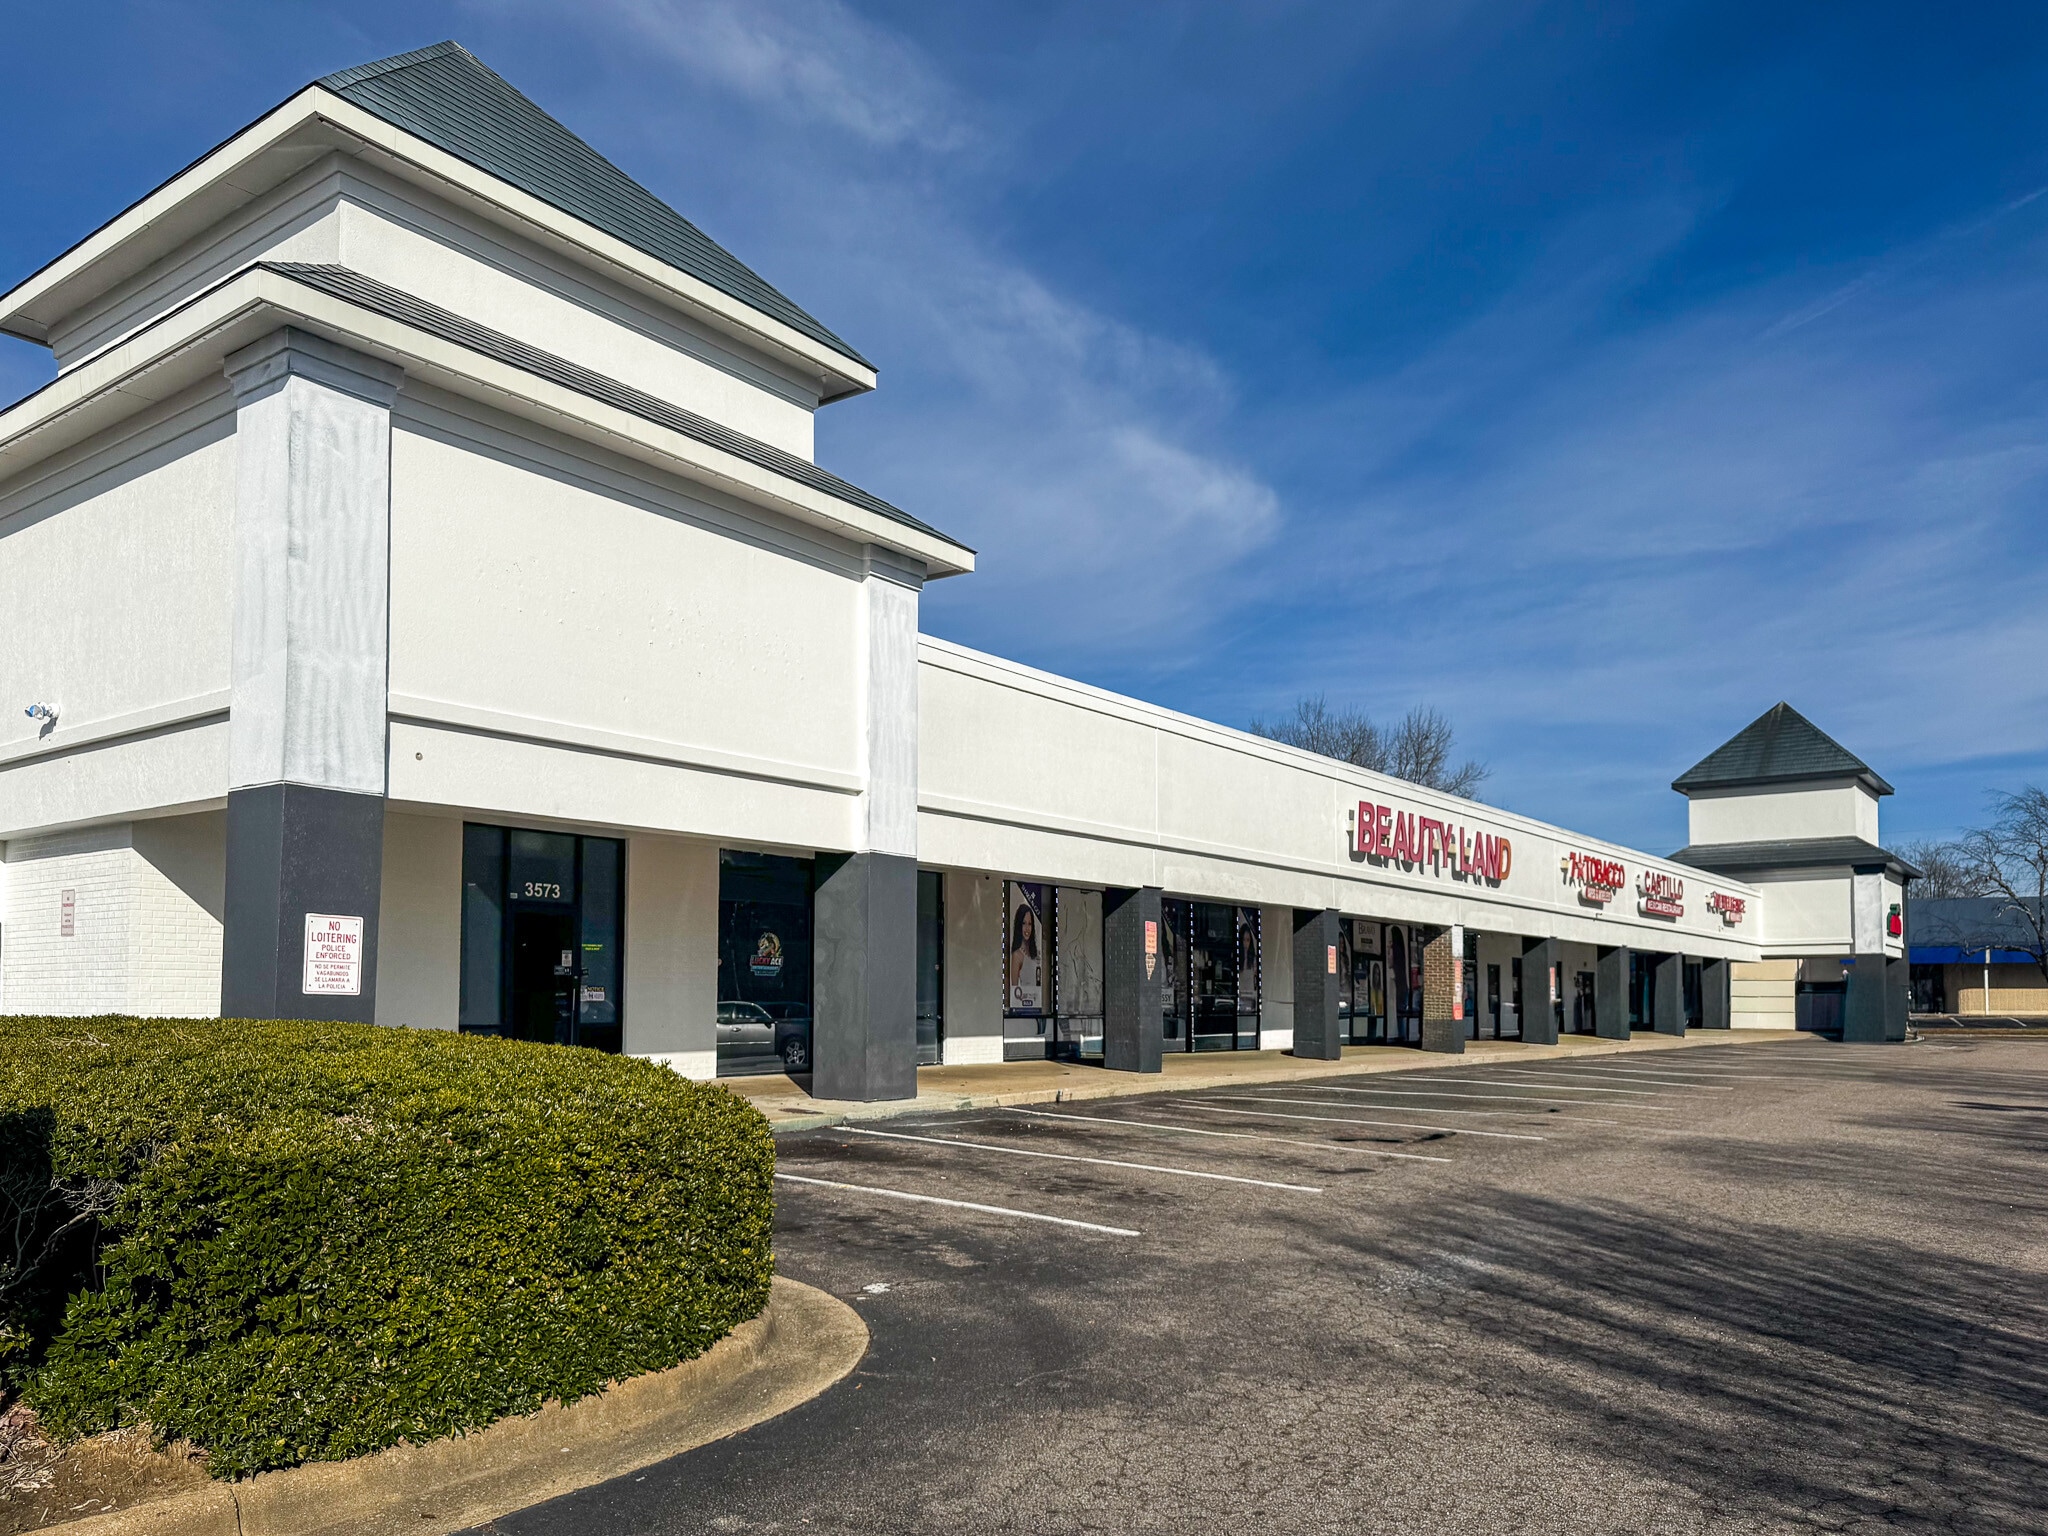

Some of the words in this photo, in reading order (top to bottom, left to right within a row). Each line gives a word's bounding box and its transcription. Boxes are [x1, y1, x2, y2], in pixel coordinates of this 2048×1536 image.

[1358, 800, 1453, 868] BEAUTY
[1460, 827, 1512, 880] LAND
[1584, 855, 1625, 889] TOBACCO
[525, 882, 560, 898] 3573
[1645, 870, 1684, 900] CASTILLO
[329, 921, 340, 931] NO
[311, 932, 357, 944] LOITERING
[321, 944, 345, 952] POLICE
[315, 952, 351, 960] ENFORCED
